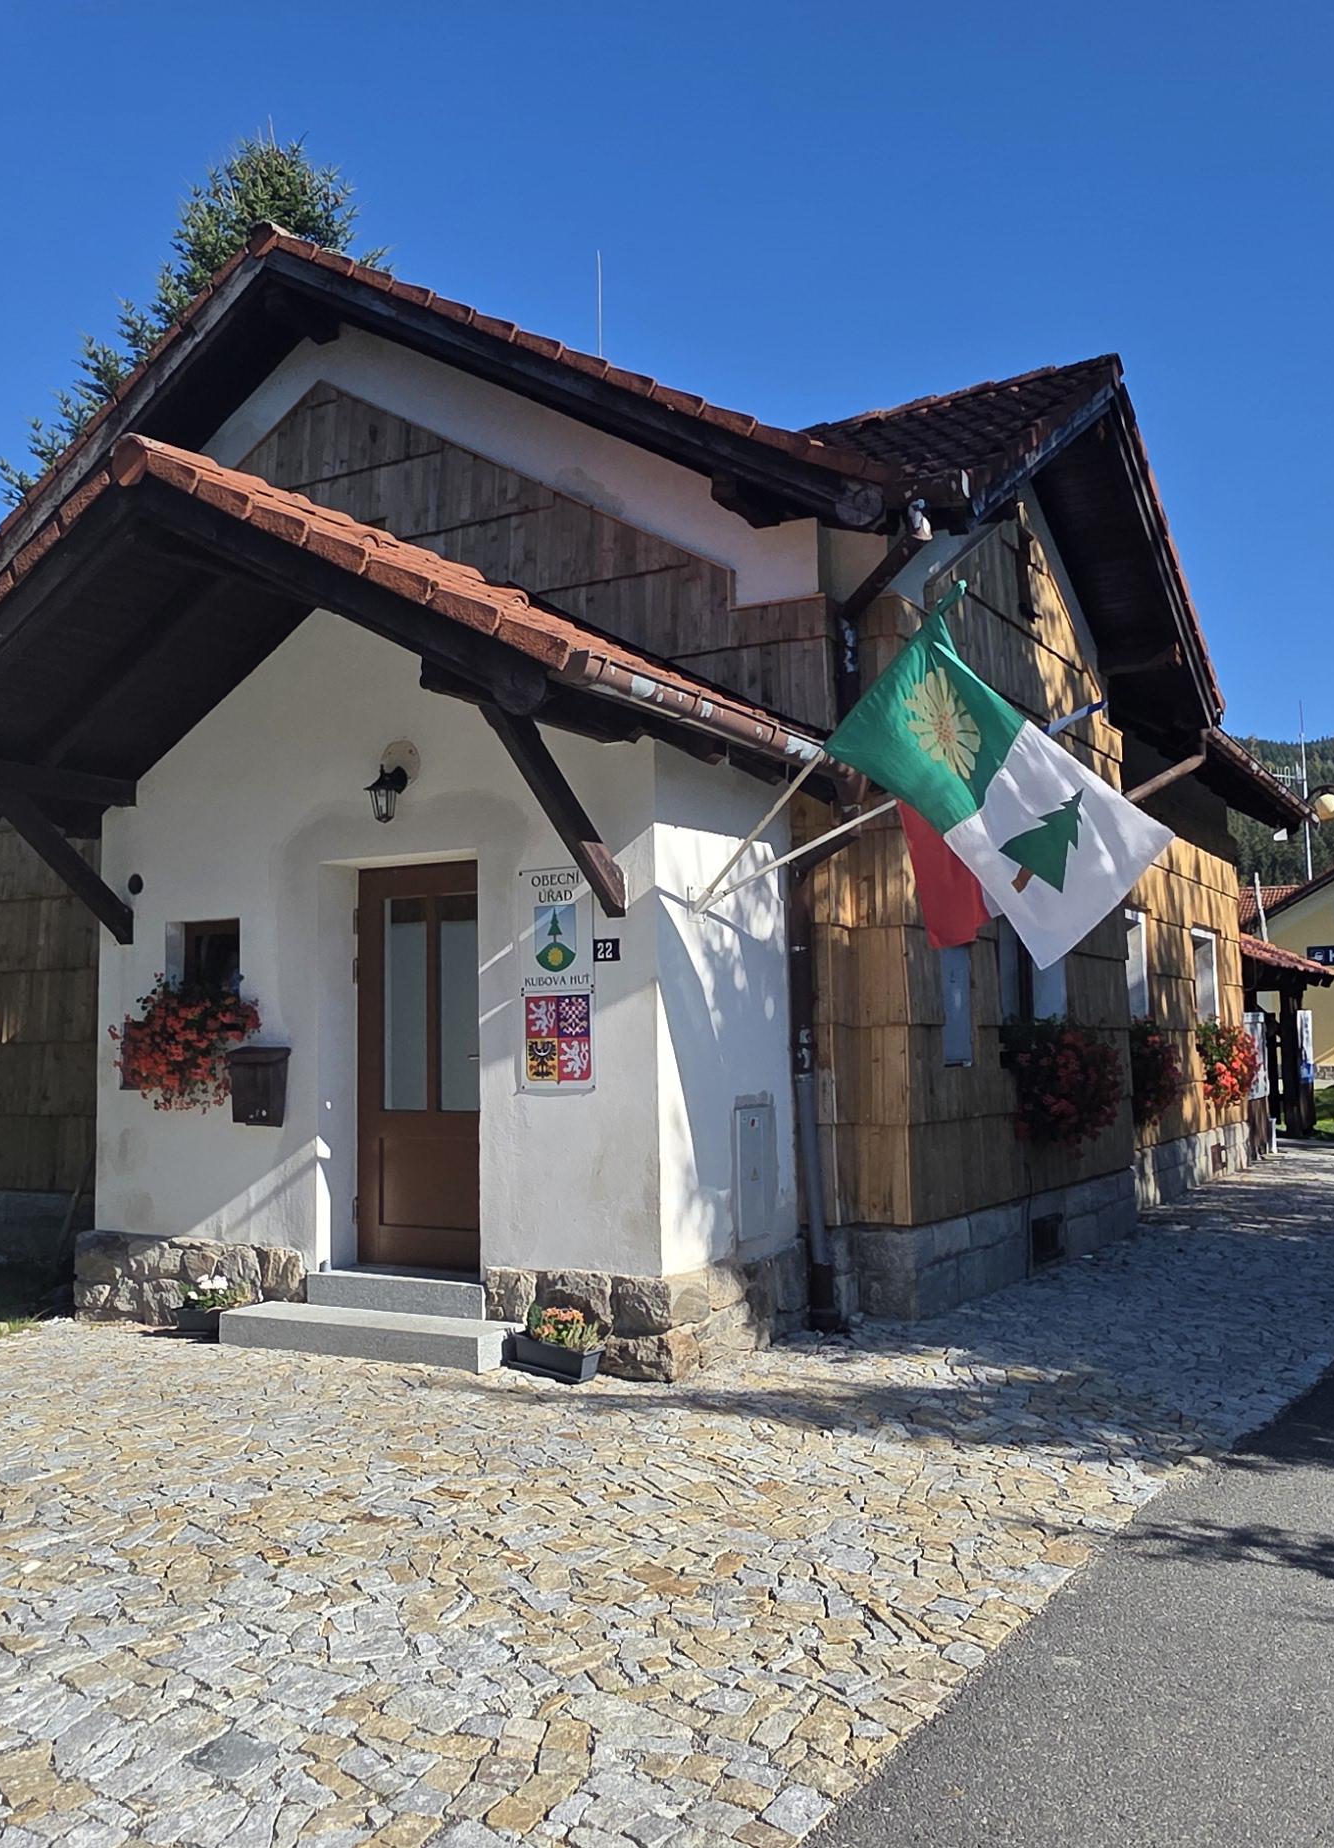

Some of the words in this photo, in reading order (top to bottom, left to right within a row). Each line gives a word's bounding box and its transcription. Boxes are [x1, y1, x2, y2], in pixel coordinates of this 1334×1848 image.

[531, 870, 579, 887] OBECNÍ
[538, 888, 573, 903] ÚŘAD
[597, 942, 613, 959] 22
[524, 975, 567, 987] KUBOVA
